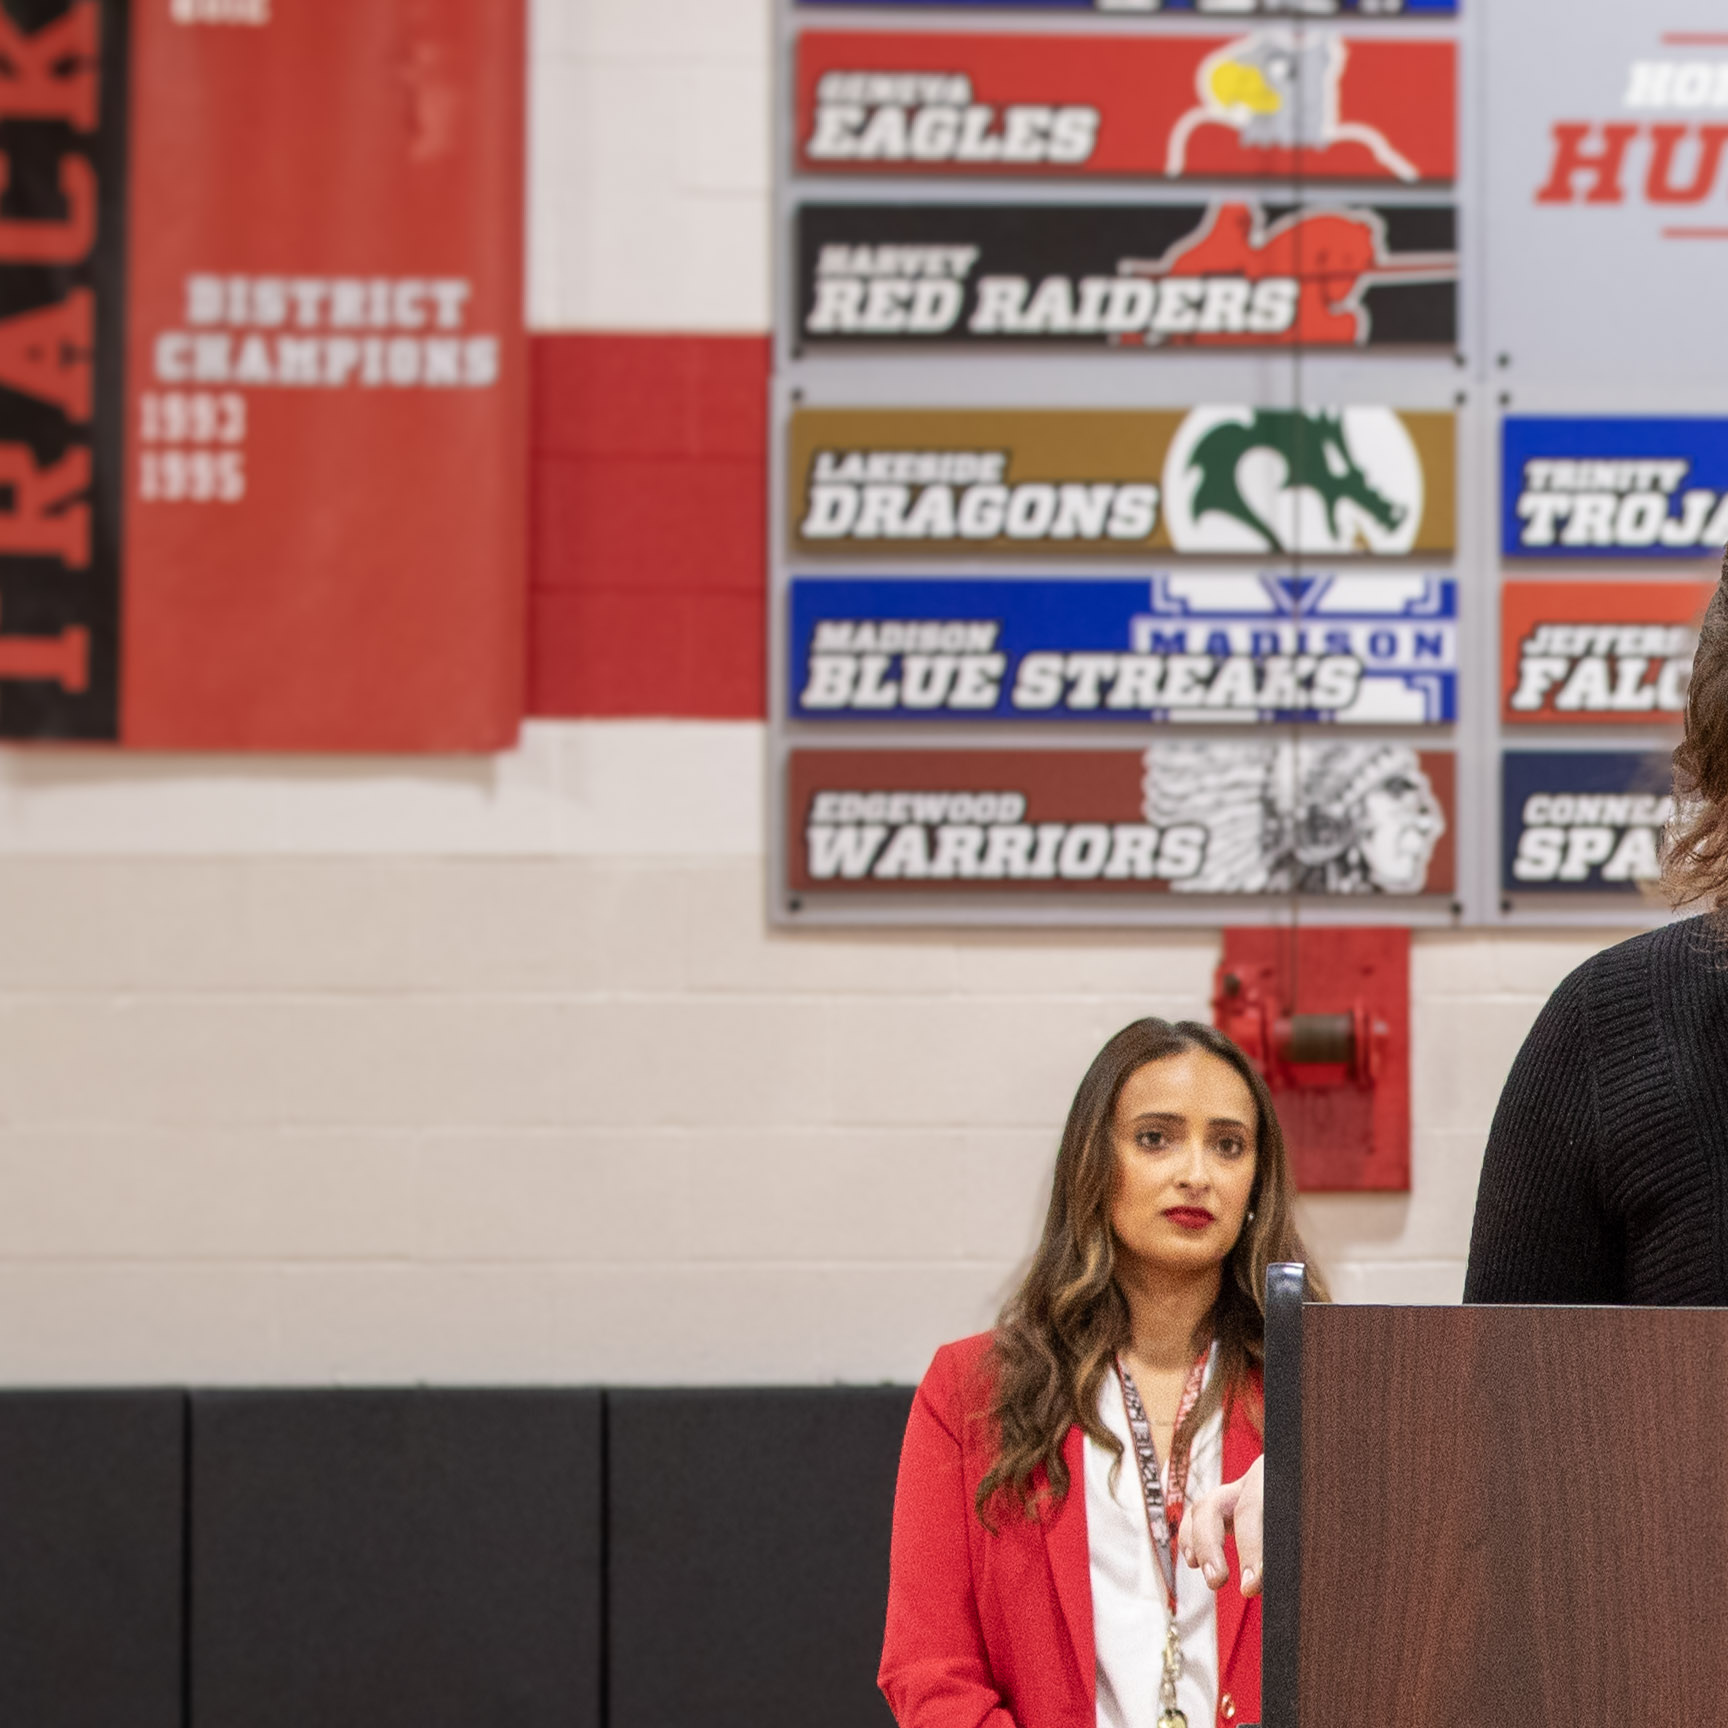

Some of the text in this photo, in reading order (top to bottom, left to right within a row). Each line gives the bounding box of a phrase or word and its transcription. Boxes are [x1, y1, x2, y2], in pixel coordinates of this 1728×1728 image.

[807, 107, 1099, 162] EAGLES
[818, 246, 979, 277] HARVEY
[185, 275, 470, 330] DISTRICT
[807, 279, 1300, 333] RED RAIDERS
[153, 333, 499, 387] CHAMPIONS
[813, 450, 1009, 485] LAKESIDE
[1524, 459, 1690, 493] TRINITY
[801, 483, 1159, 539] DRAGONS
[812, 622, 998, 654] MADISON
[801, 653, 1364, 710] BLUE STREAKS
[1511, 656, 1692, 712] FALC
[811, 792, 1026, 826] EDGEWOOD
[806, 825, 1208, 880] WARRIORS
[1513, 826, 1664, 880] SPA
